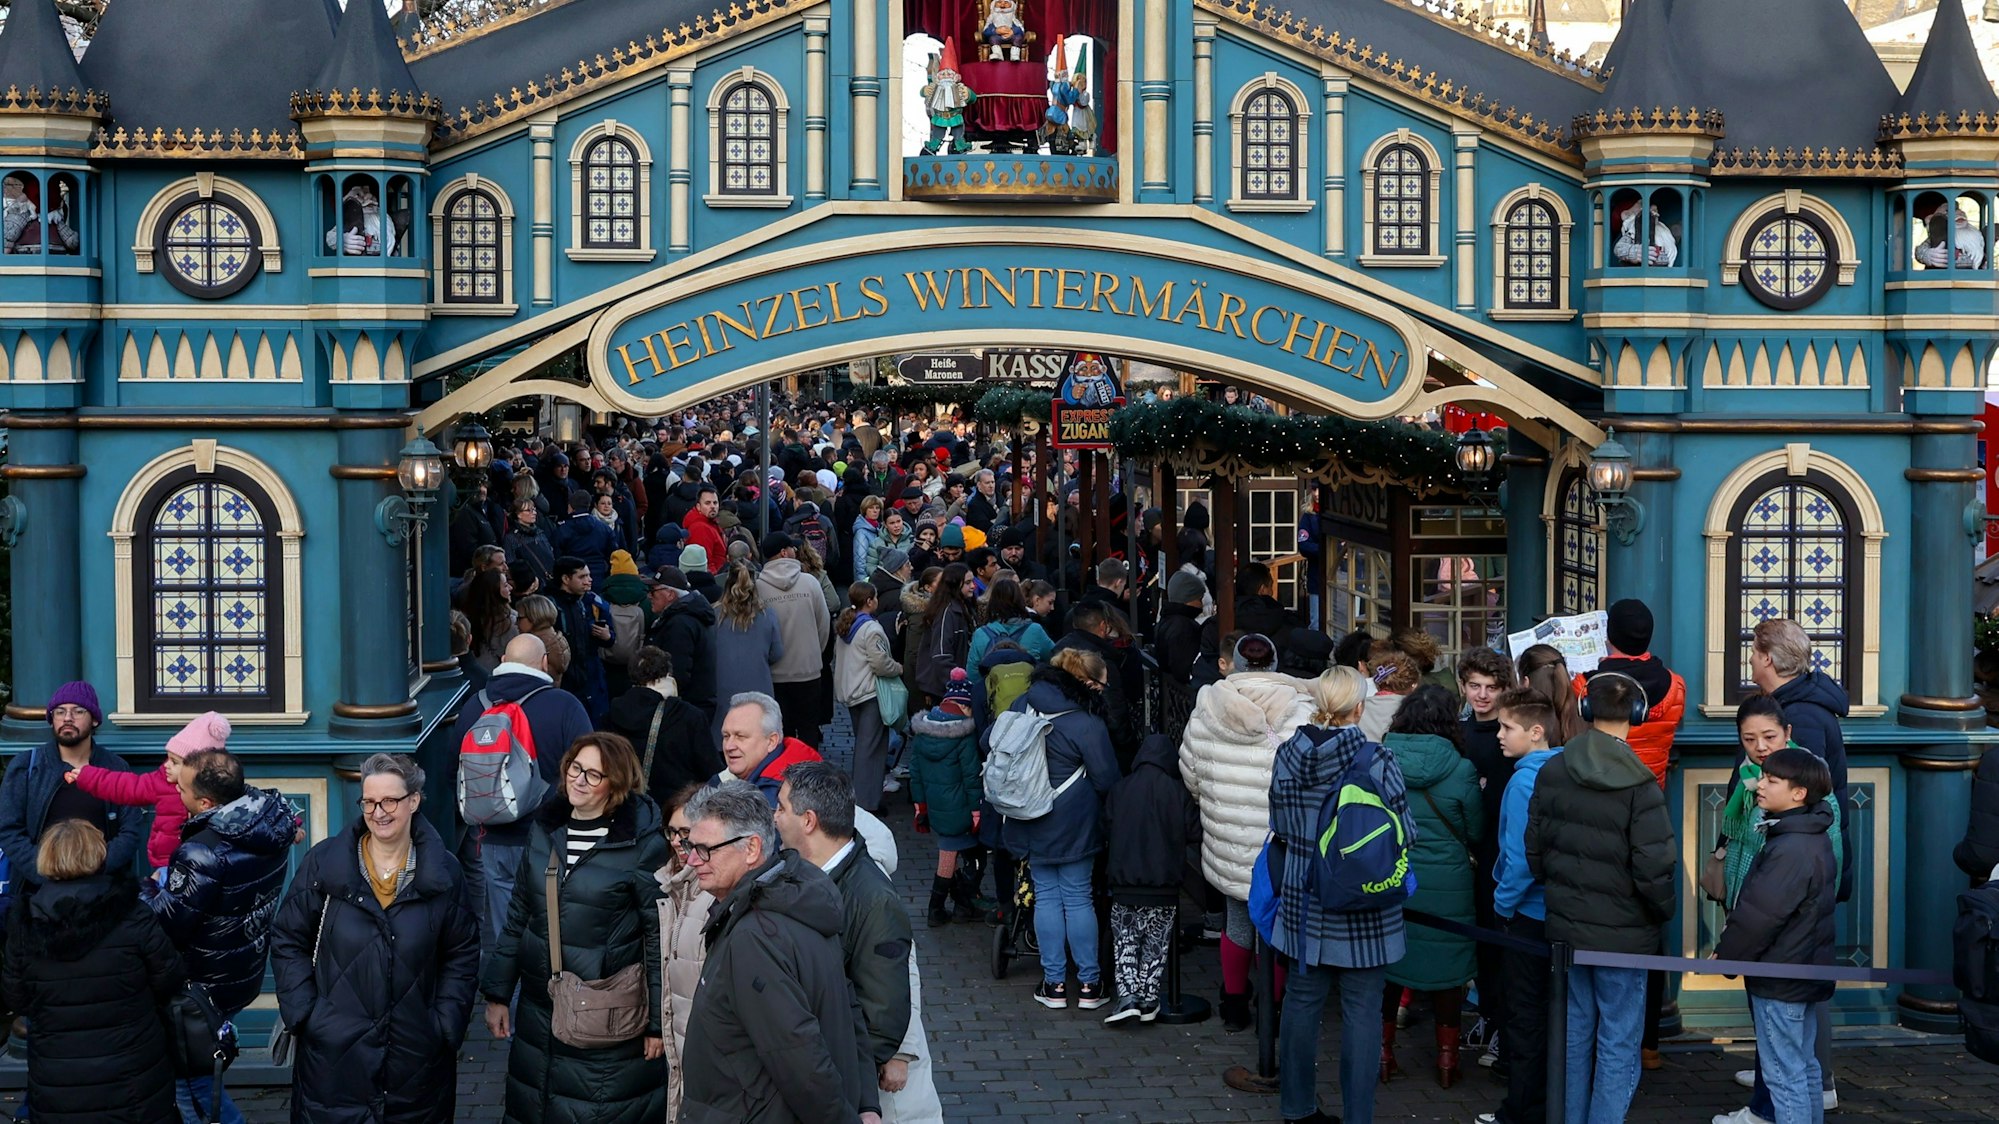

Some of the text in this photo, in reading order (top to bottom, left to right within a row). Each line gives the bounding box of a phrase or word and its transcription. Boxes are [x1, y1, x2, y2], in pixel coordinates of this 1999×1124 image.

[615, 267, 1403, 390] HEINZELS WINTERMÄRCHEN
[930, 358, 957, 368] Heiße
[924, 370, 963, 380] Maronen
